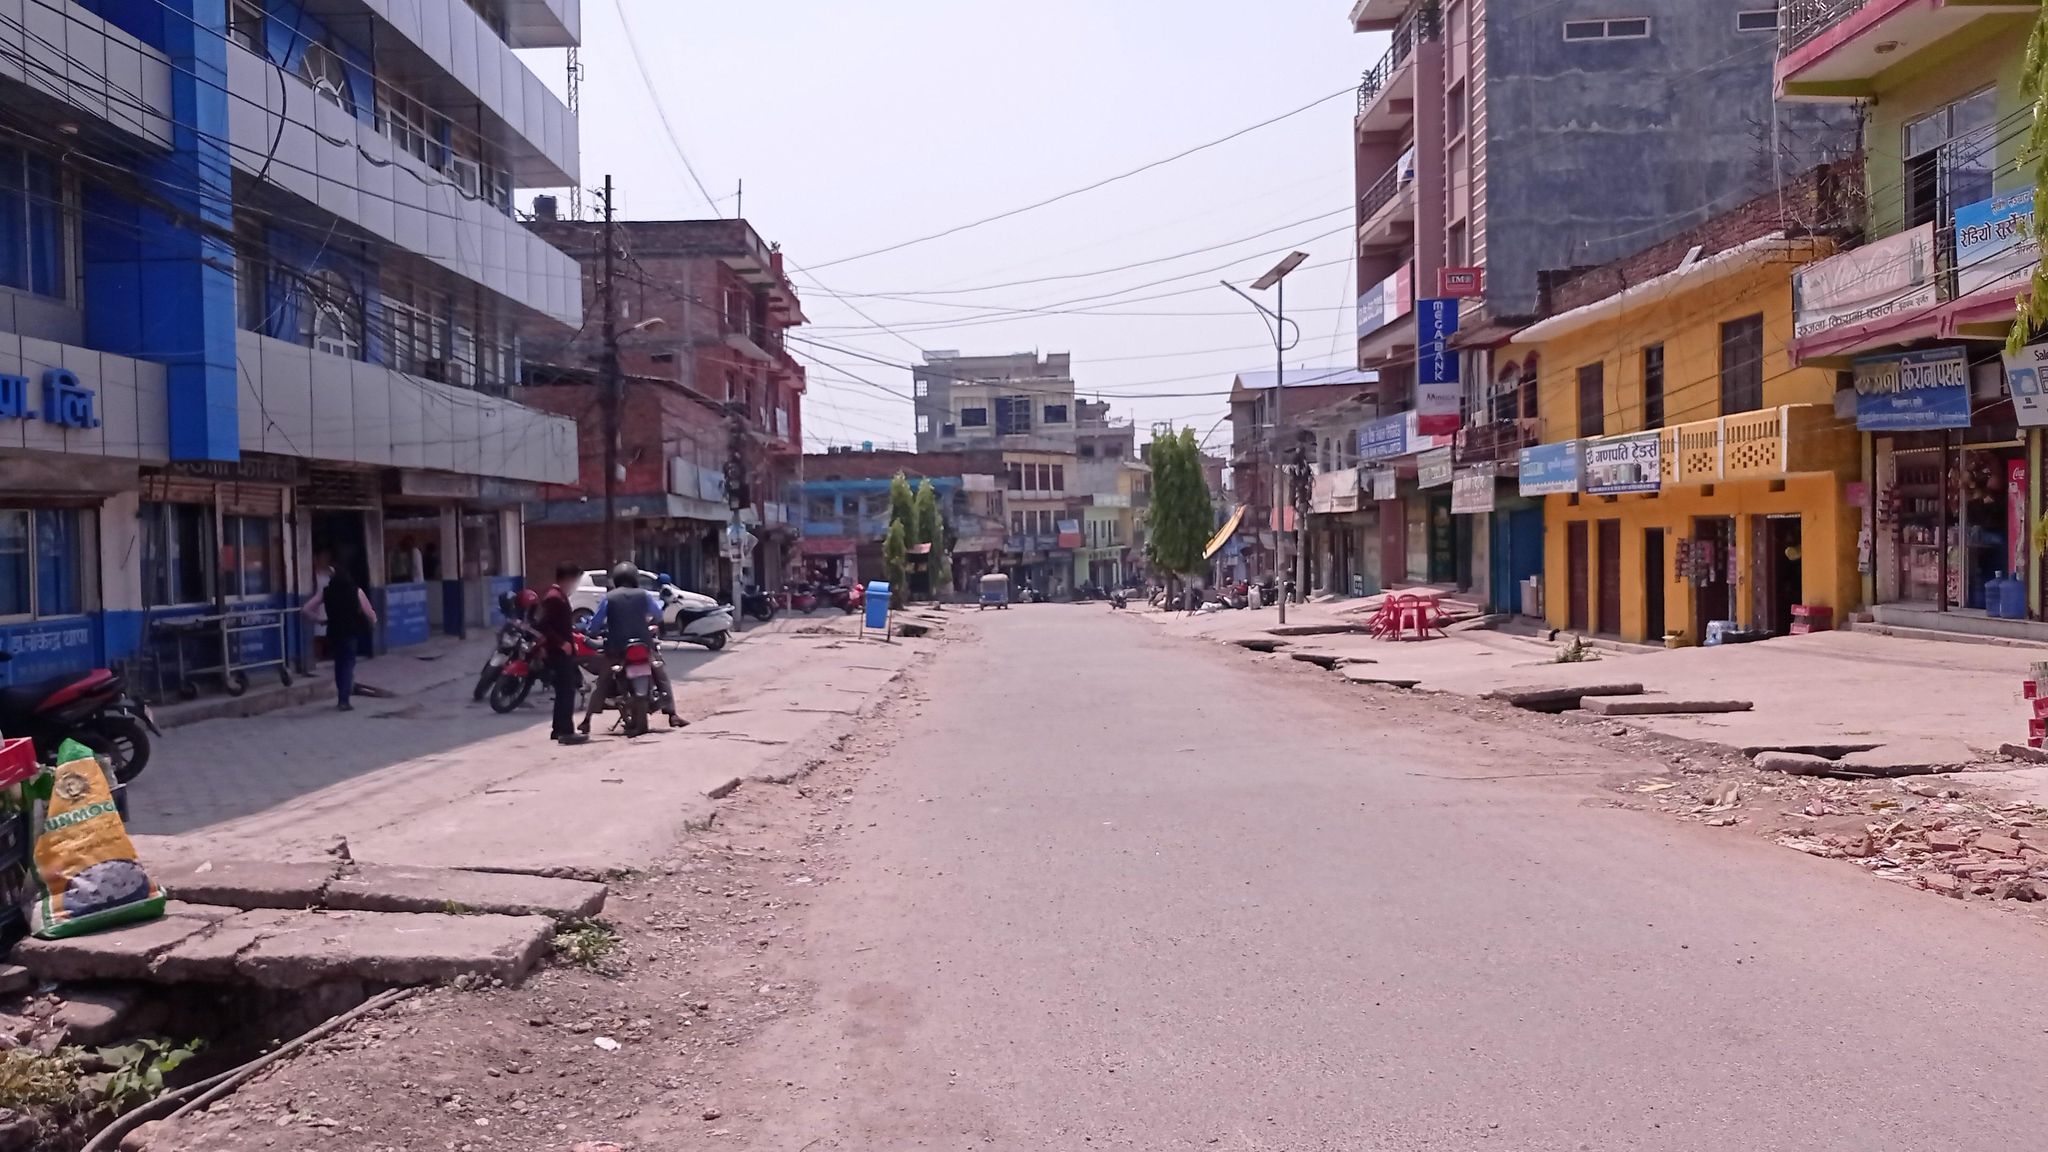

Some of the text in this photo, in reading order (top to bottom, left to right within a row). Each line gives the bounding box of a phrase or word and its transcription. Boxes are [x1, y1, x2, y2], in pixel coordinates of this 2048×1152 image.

[1961, 221, 1992, 247] रेडियो
[1901, 357, 1937, 390] किराना
[42, 368, 100, 428] लि.
[1595, 443, 1628, 463] गणपति
[1632, 440, 1658, 463] ट्रेडर्स
